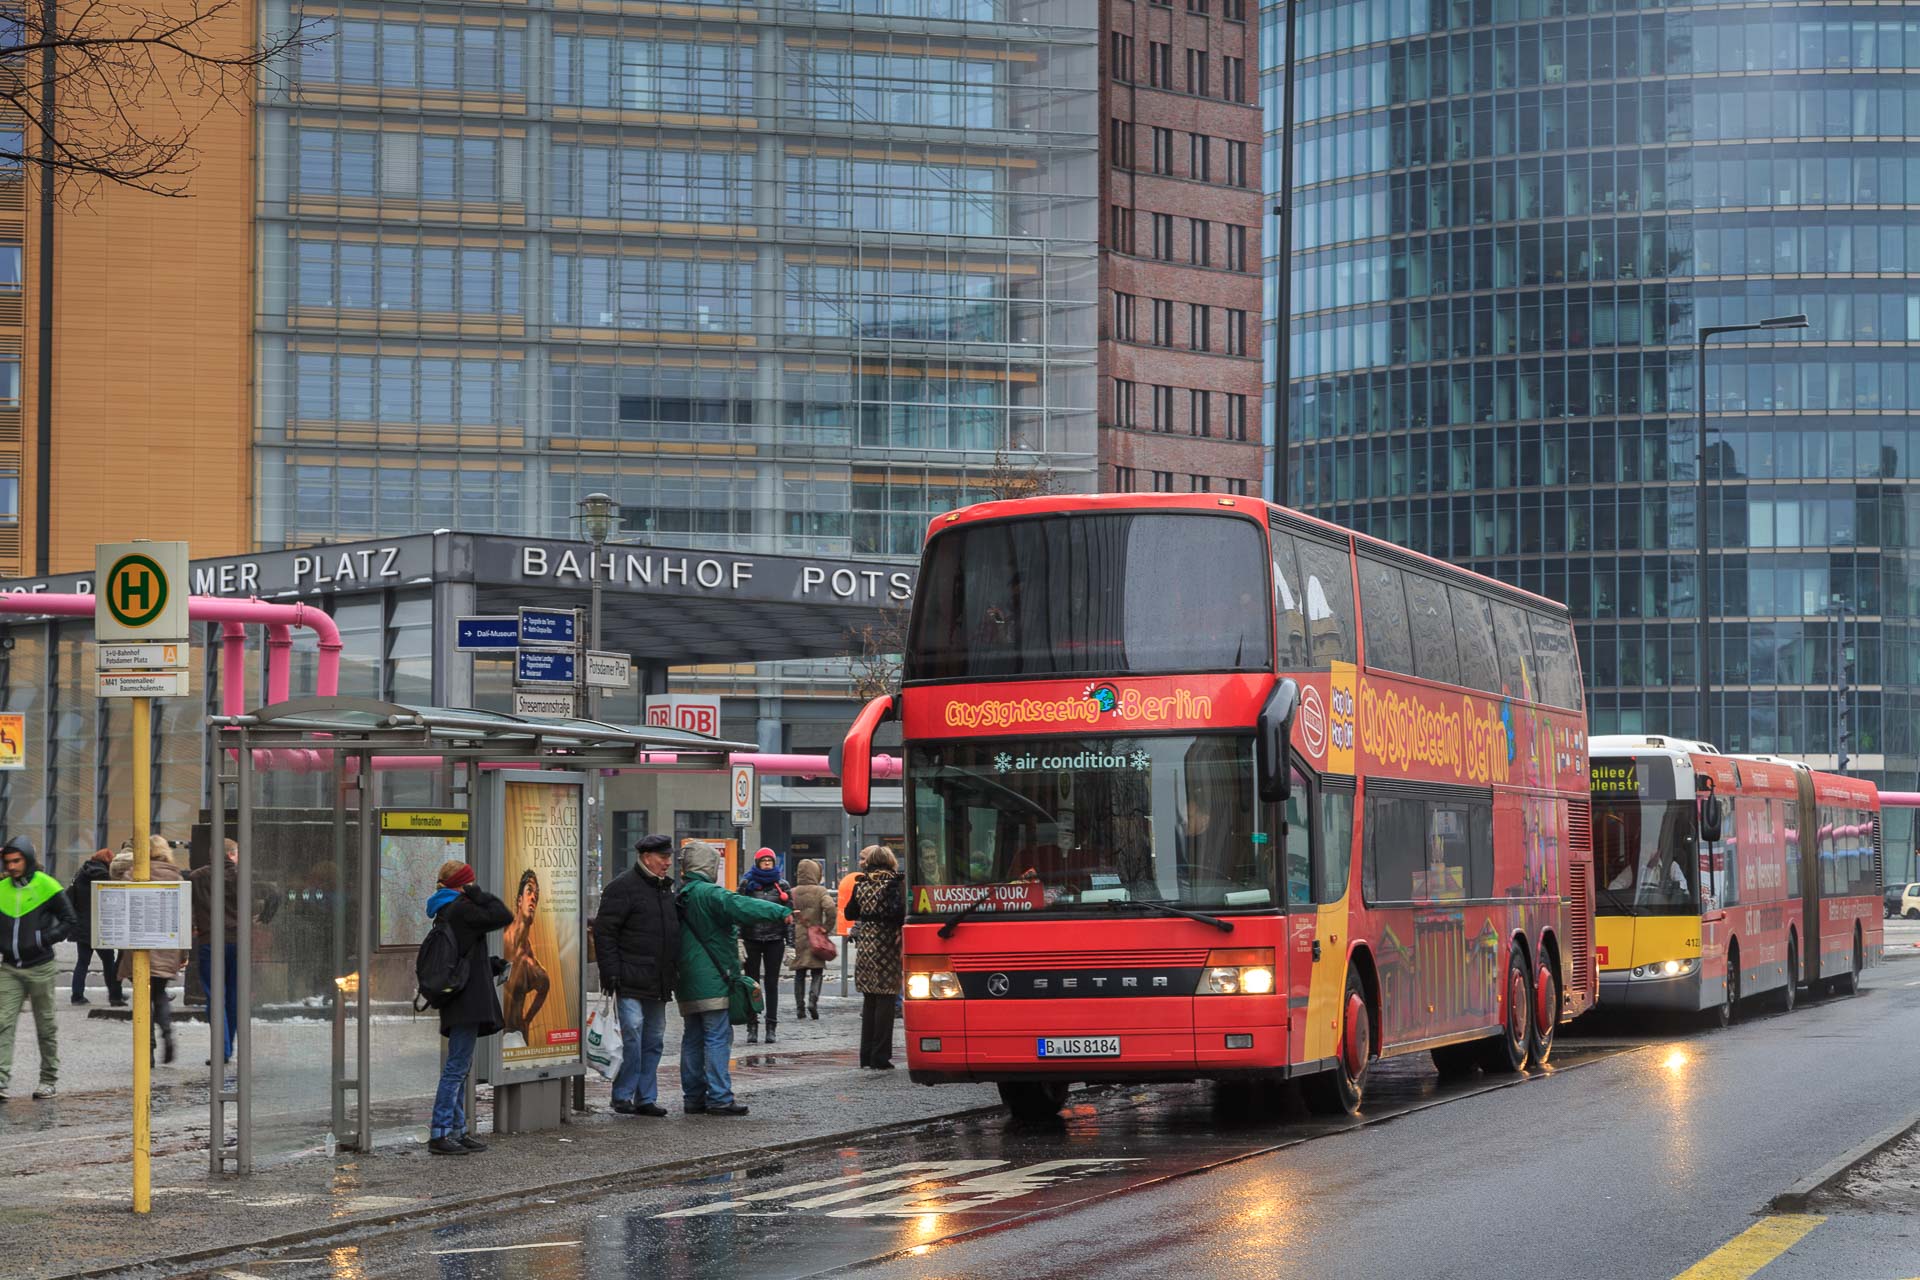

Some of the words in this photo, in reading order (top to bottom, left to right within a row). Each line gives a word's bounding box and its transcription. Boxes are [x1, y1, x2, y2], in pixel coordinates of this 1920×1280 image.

[294, 547, 400, 584] PLATZ
[523, 547, 754, 589] BAHNHOF
[121, 571, 149, 610] H
[133, 656, 148, 664] Platz
[165, 647, 176, 663] A
[589, 658, 615, 676] Potsdamer
[105, 678, 118, 686] M41
[119, 677, 156, 685] Sonnenallee/
[519, 695, 570, 717] Stresemannstraße
[945, 697, 1100, 728] CitySightseeing
[1121, 688, 1212, 721] Berlin
[1332, 685, 1344, 719] Hop
[1344, 687, 1354, 718] On
[681, 709, 711, 732] DB
[1359, 677, 1462, 778] CitySightseeing
[1463, 694, 1510, 784] Berlin
[1331, 718, 1343, 752] Hop
[1344, 720, 1354, 750] Off
[1015, 753, 1038, 769] air
[1042, 752, 1127, 769] condition
[410, 815, 442, 827] Information
[550, 806, 578, 826] BACH
[523, 826, 578, 850] JOHANNES
[534, 848, 577, 868] PASSION
[918, 888, 932, 913] A
[933, 888, 990, 901] KLASSISCHE
[995, 886, 1028, 899] TOUR/
[1033, 976, 1168, 988] SETRA
[1046, 1039, 1055, 1054] B
[1063, 1039, 1081, 1053] US
[1084, 1039, 1117, 1053] 8184
